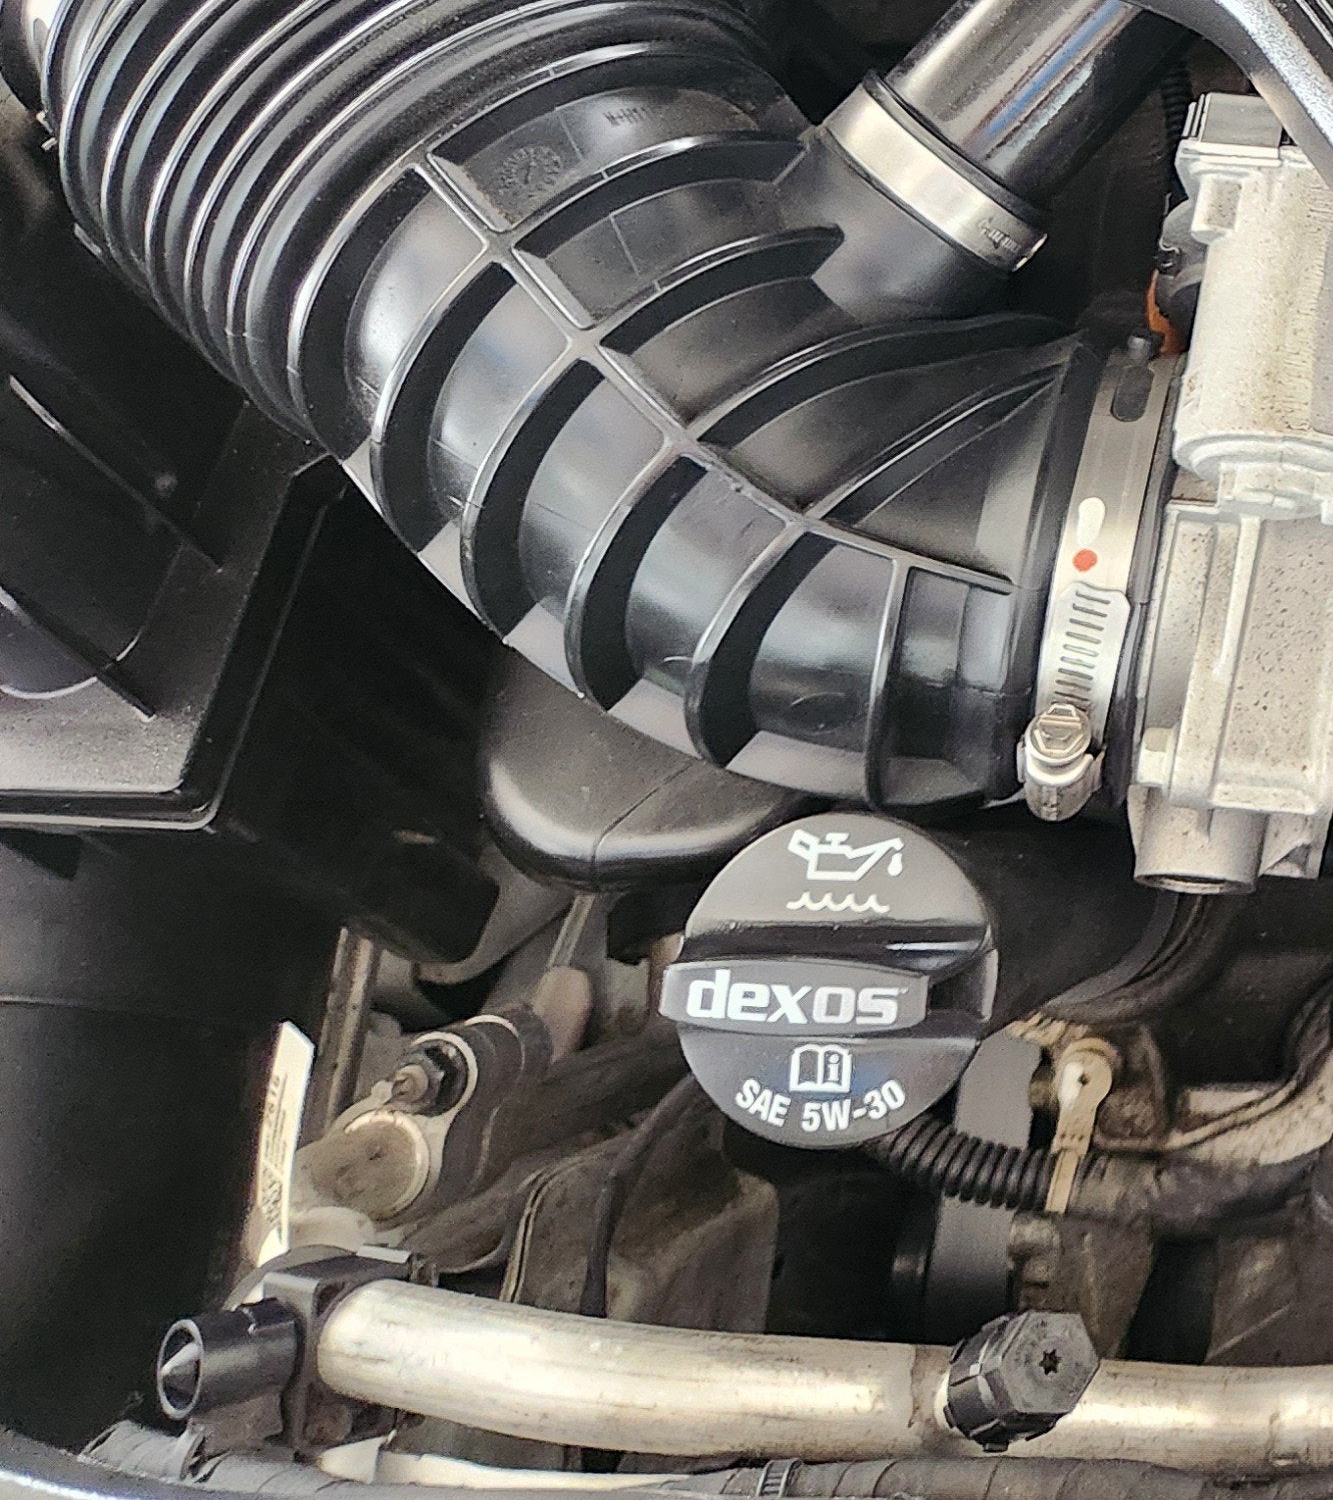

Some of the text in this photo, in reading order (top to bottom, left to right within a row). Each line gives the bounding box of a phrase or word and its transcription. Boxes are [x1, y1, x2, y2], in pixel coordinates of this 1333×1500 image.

[685, 968, 900, 1026] dexos
[735, 1078, 907, 1132] SAE 5W-30
